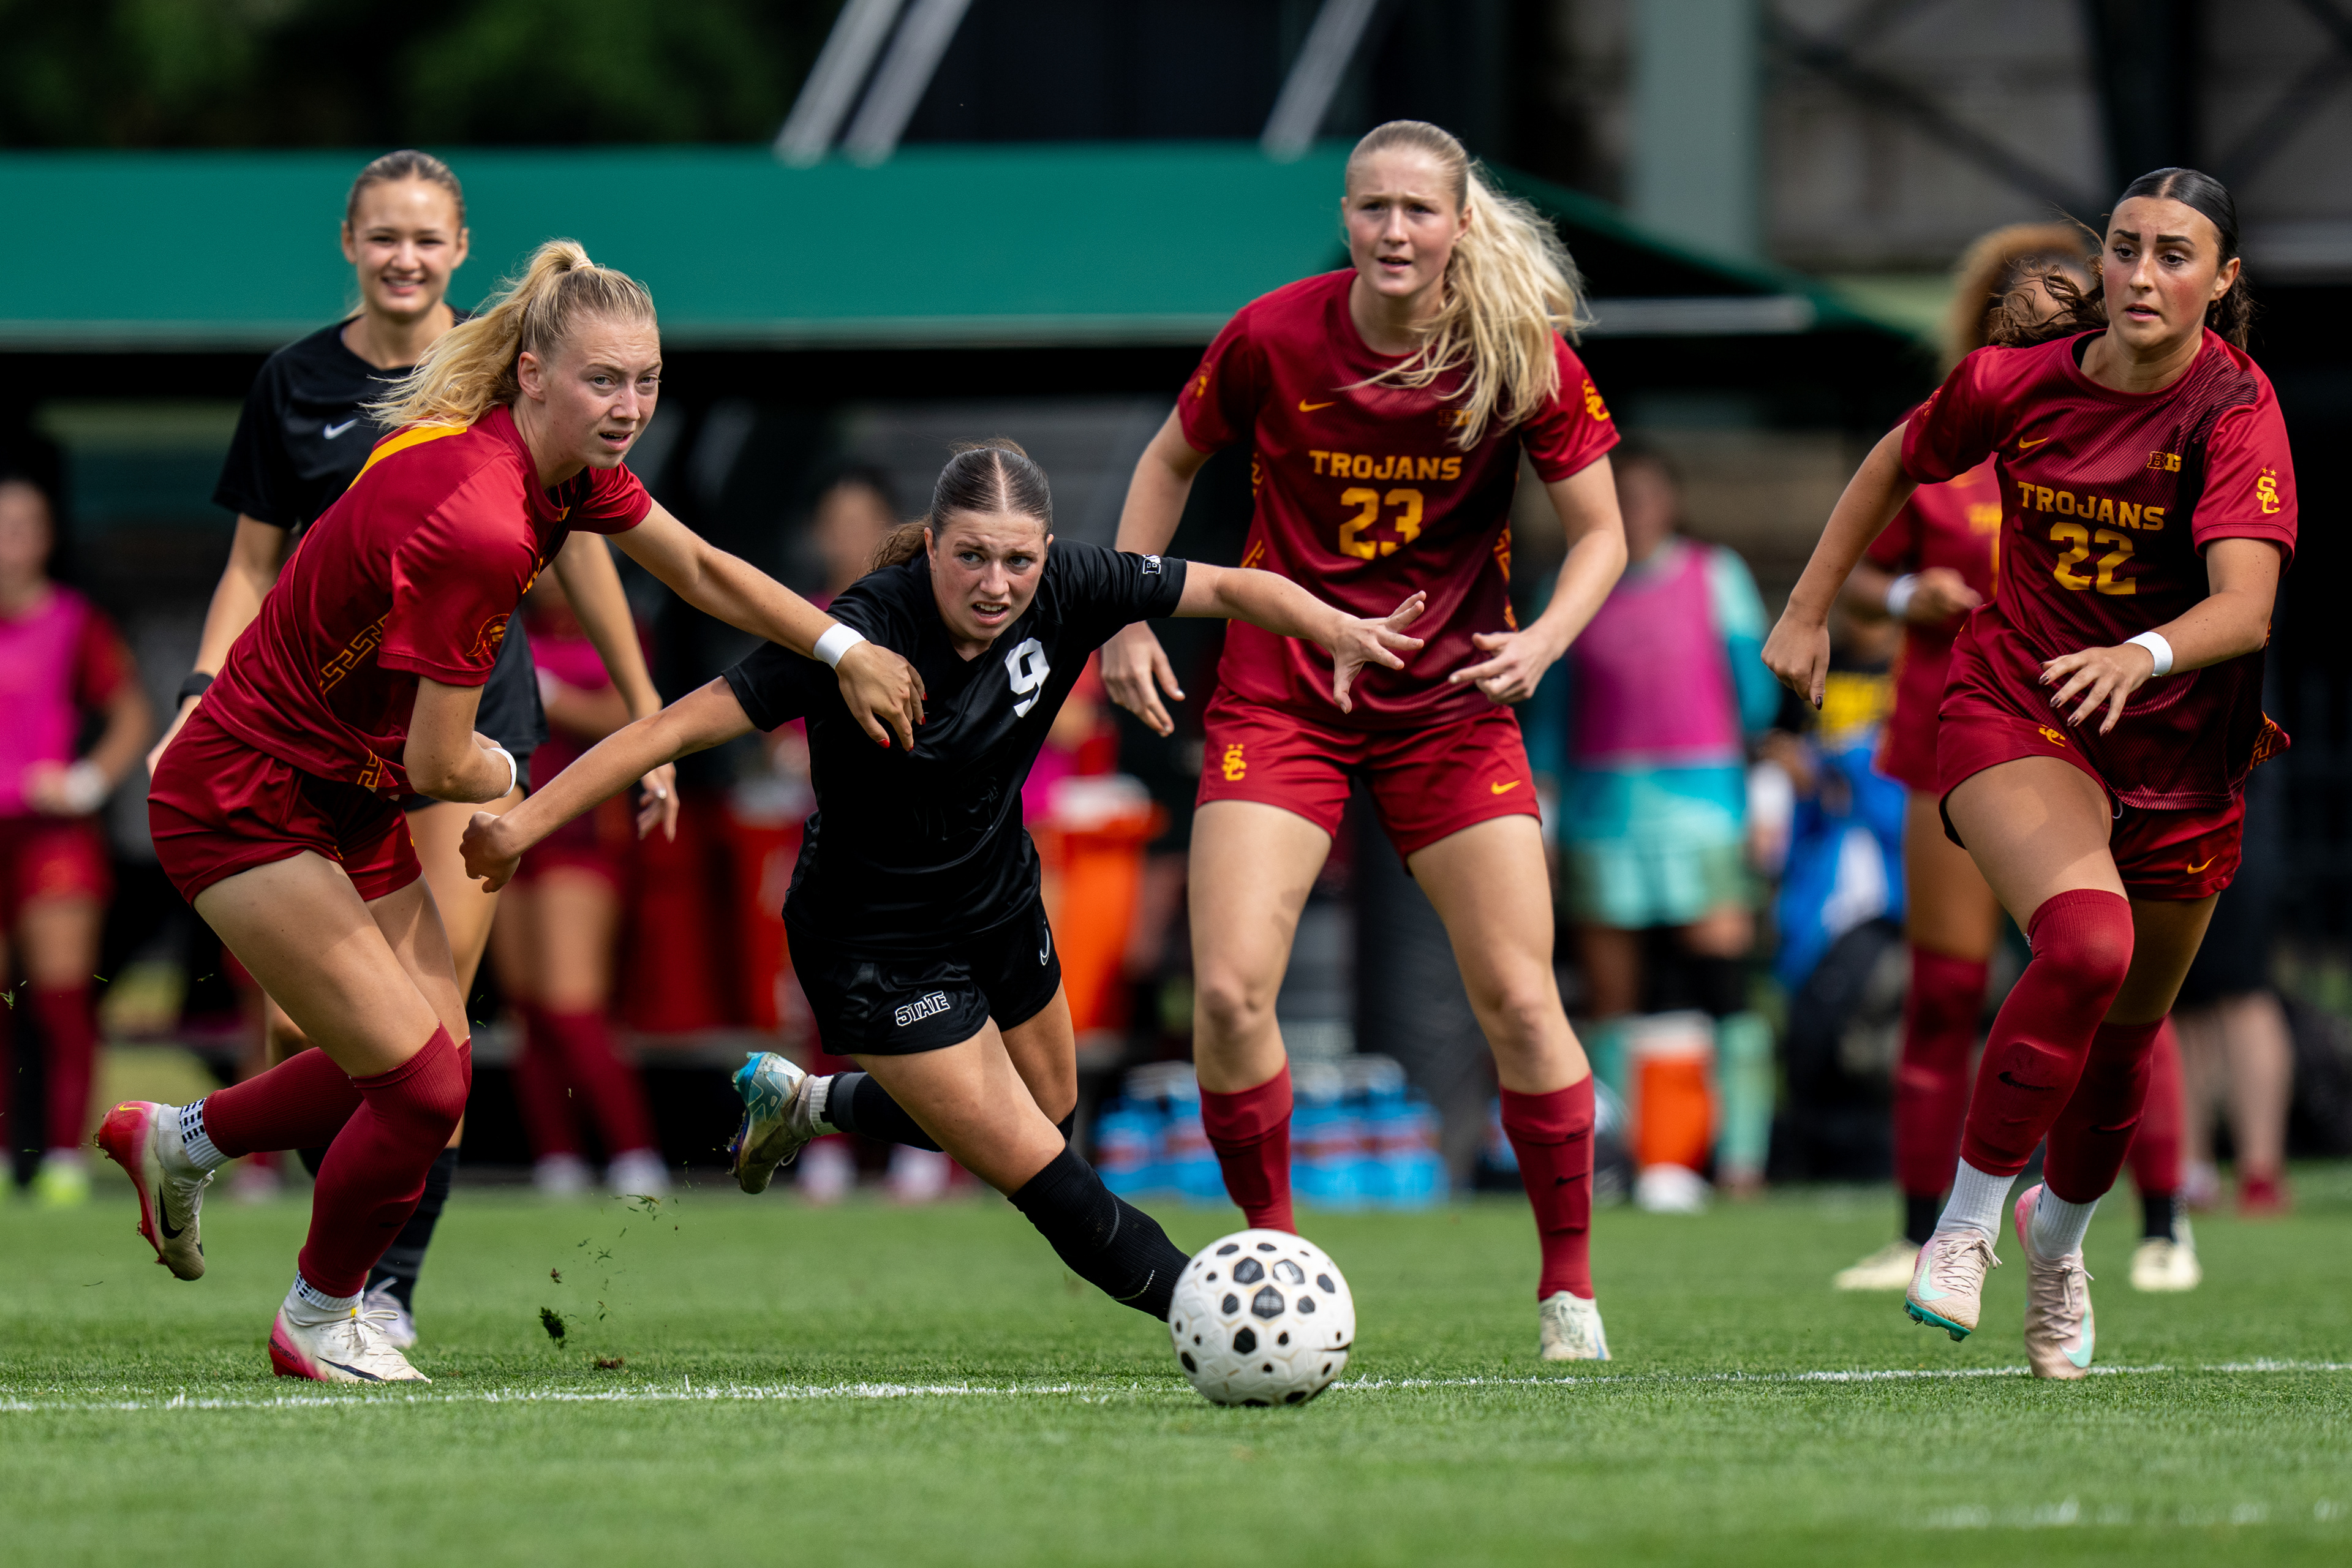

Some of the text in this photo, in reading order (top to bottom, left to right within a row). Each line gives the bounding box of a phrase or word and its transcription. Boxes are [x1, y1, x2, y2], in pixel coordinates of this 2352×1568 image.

[1308, 449, 1463, 481] TROJANS
[2018, 481, 2165, 530] TROJANS
[2256, 476, 2280, 513] SC
[1339, 487, 1424, 560] 23
[2050, 522, 2136, 595] 22
[1005, 637, 1051, 718] 9
[1221, 750, 1247, 781] SC
[895, 990, 951, 1027] STATE
